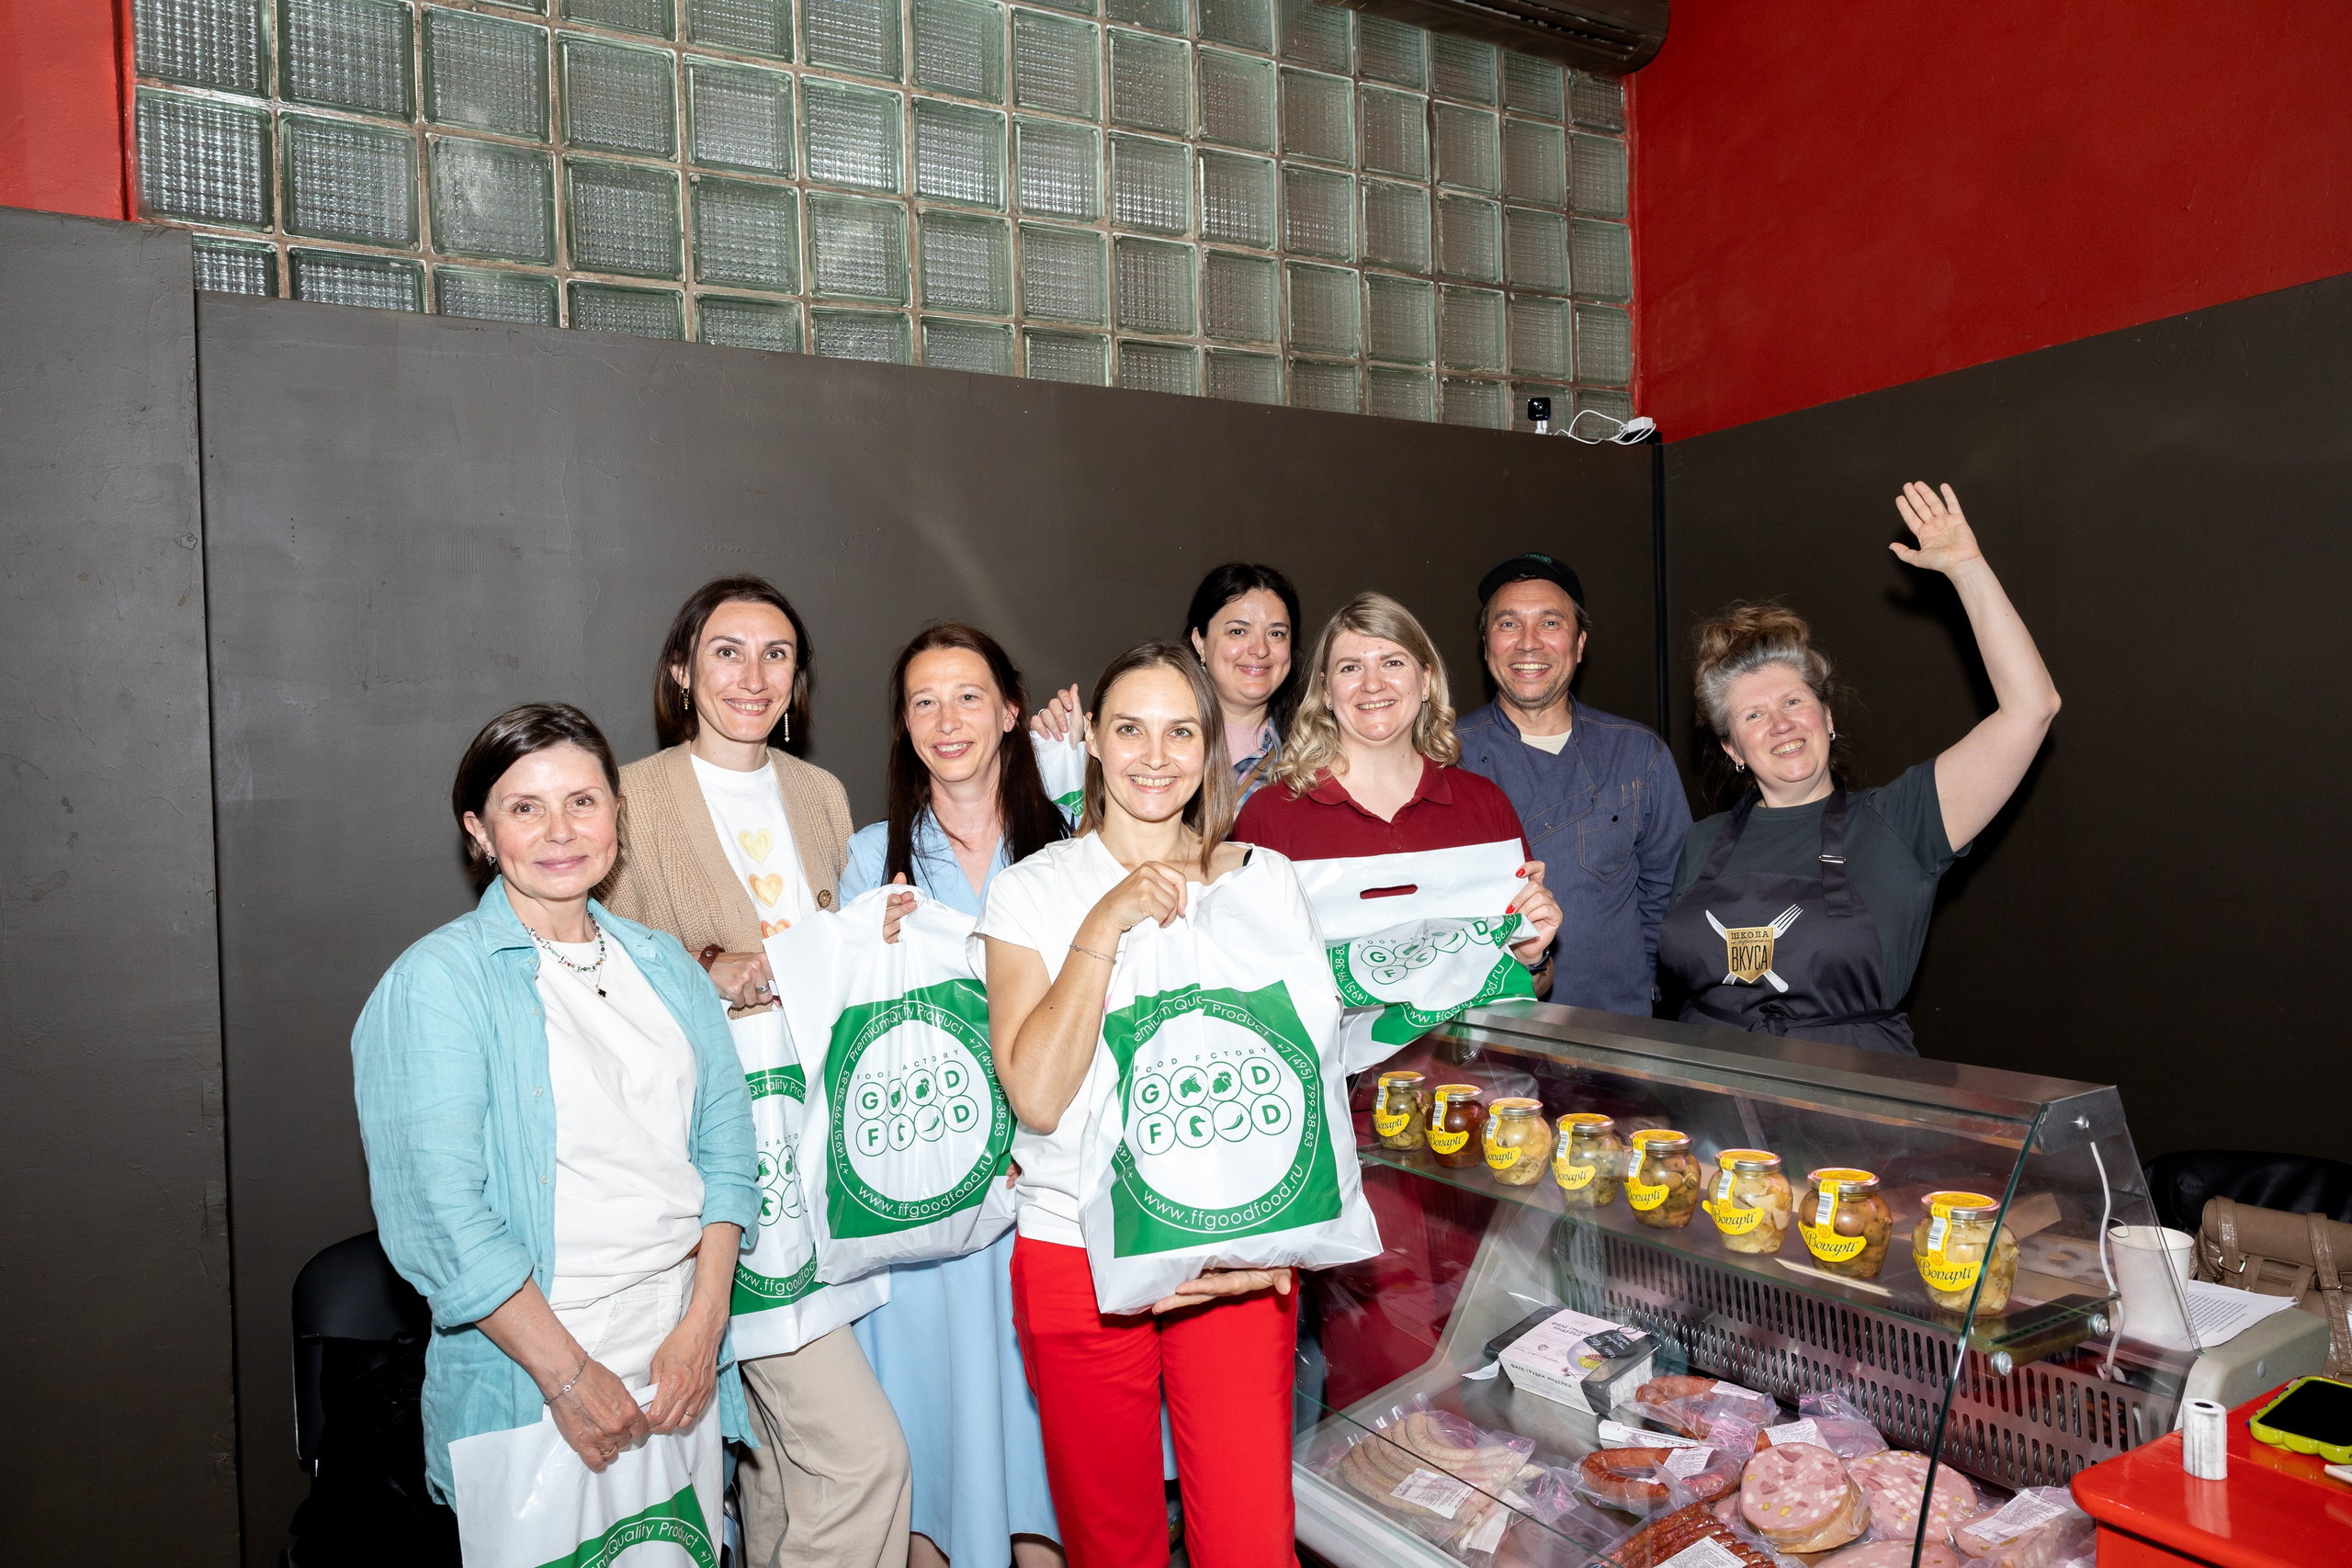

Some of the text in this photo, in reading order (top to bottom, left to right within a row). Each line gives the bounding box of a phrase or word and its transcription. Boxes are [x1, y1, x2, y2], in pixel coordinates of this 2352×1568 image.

[1731, 931, 1769, 940] ШКОЛА
[1731, 944, 1768, 972] ВКУСА
[849, 1016, 891, 1062] Premium
[917, 1005, 964, 1035] Product
[1135, 1005, 1171, 1042] emium
[1213, 1003, 1269, 1037] Product
[969, 1037, 983, 1049] +7
[902, 1049, 959, 1071] ACTORY
[1135, 1046, 1267, 1073] FOOD FCTORY
[748, 1078, 788, 1097] Quality
[1277, 1043, 1316, 1147] +7 (495) 799-38-83
[834, 1070, 850, 1175] +7 (495) 799-38-83
[765, 1133, 799, 1147] FACTO
[858, 1153, 993, 1218] www.ffgoodfood.ru
[1144, 1164, 1303, 1230] www.ffgoodfood.ru
[608, 1524, 655, 1555] Quality
[659, 1521, 699, 1549] Product
